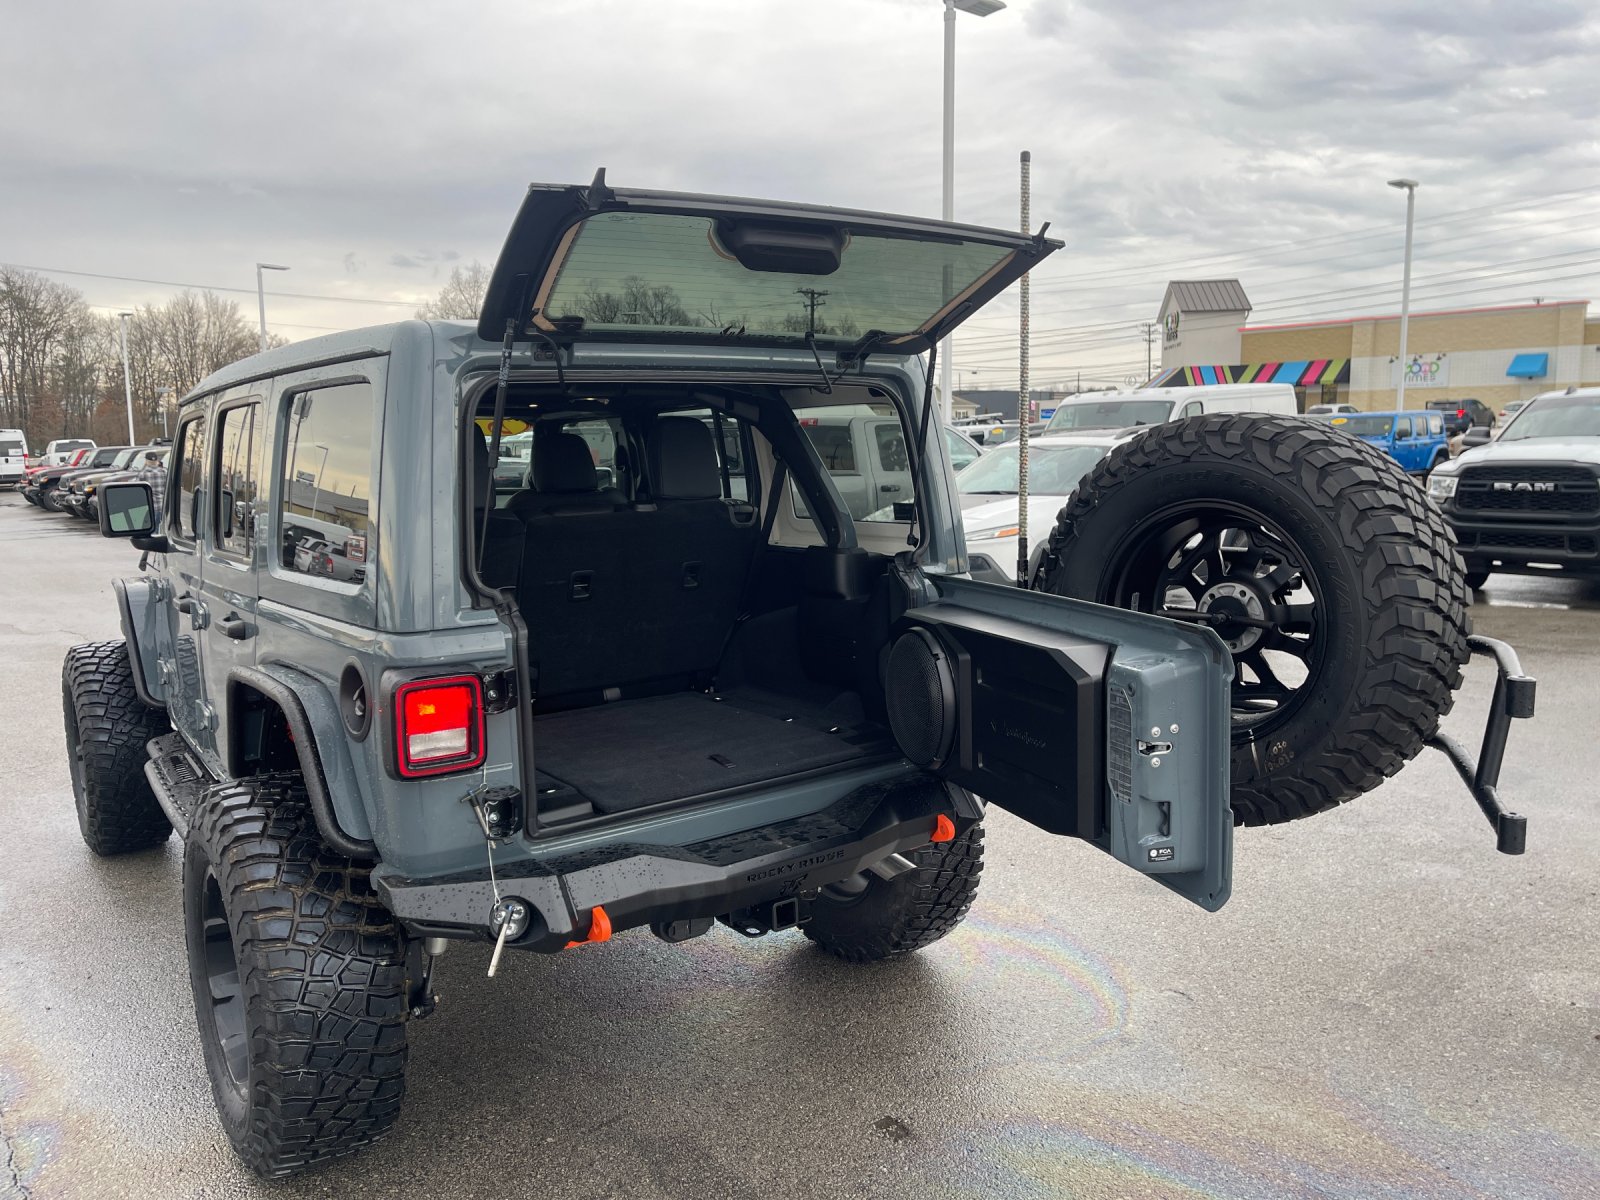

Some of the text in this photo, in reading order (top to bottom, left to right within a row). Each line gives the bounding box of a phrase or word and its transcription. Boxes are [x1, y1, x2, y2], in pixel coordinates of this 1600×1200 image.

[1493, 482, 1555, 492] RAM
[747, 850, 844, 882] ROCKY RIDGE
